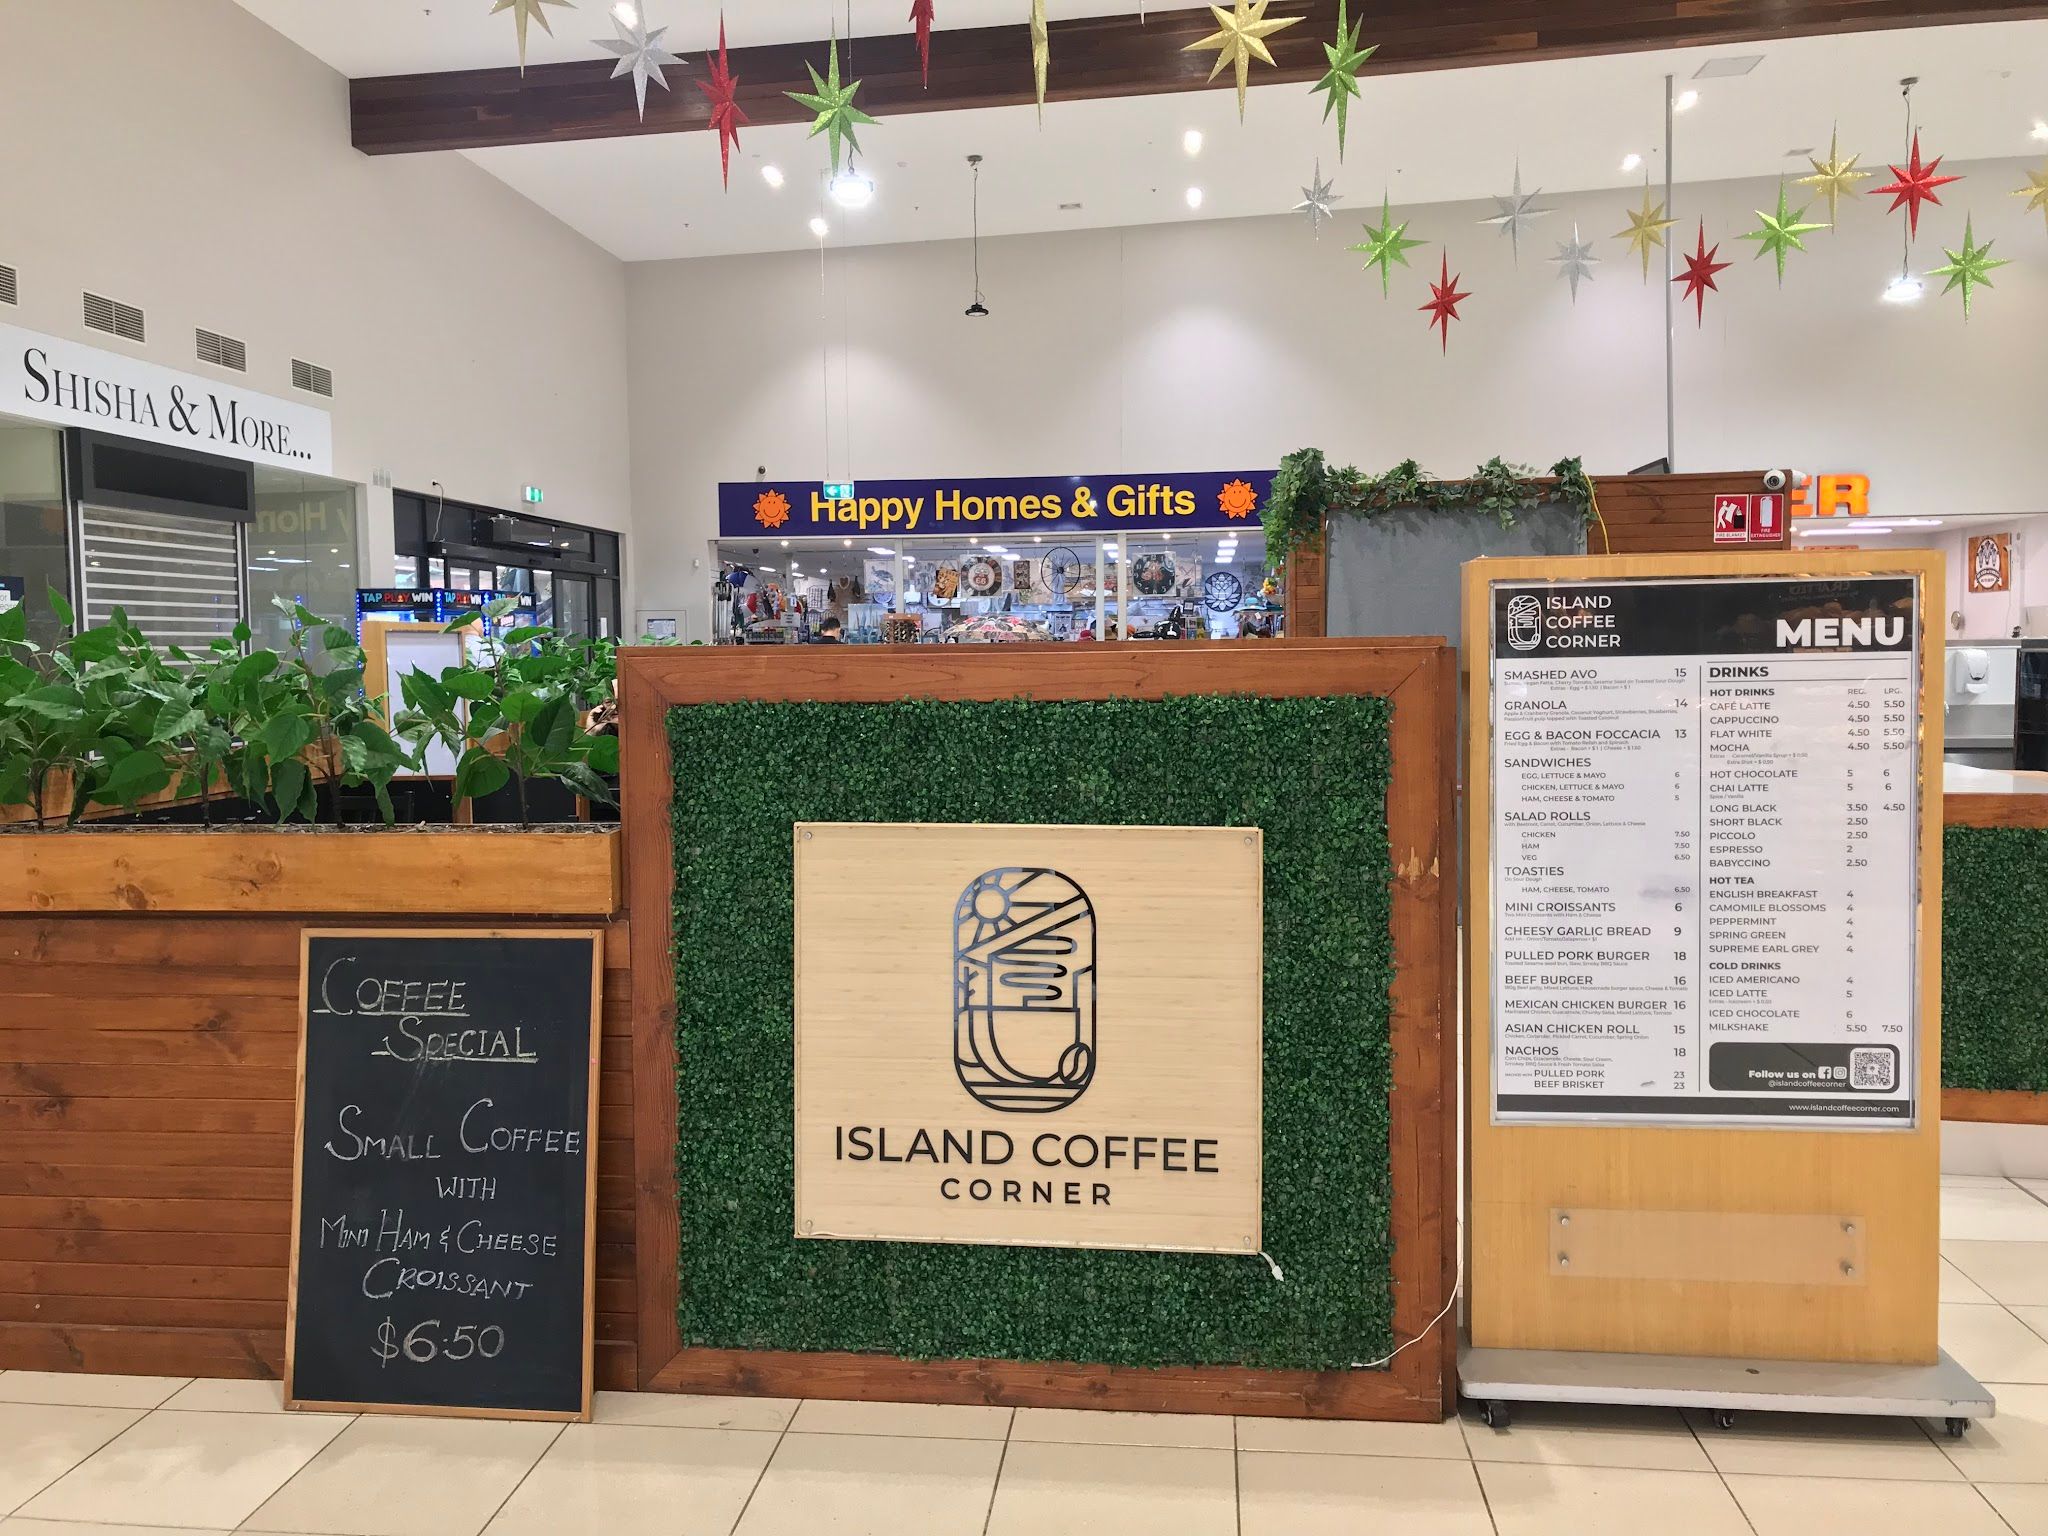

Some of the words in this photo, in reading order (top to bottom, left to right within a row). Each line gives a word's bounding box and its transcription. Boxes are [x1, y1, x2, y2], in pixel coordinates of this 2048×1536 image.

[168, 384, 200, 436] &
[811, 492, 924, 530] Happy
[935, 489, 1062, 521] Homes
[1071, 486, 1098, 518] &
[1106, 484, 1196, 517] Gifts
[363, 593, 382, 603] TAP
[411, 593, 433, 602] WIN
[445, 593, 456, 603] TAP
[1546, 596, 1611, 609] ISLAND
[1546, 615, 1615, 628] COFFEE
[1776, 617, 1904, 648] MENU
[1546, 634, 1620, 648] CORNER
[1504, 671, 1567, 680] SMASHED
[1570, 670, 1597, 678] AVO
[1675, 668, 1687, 677] 15
[1710, 666, 1769, 677] DRINKS
[1504, 701, 1567, 710] GRANOLA
[1675, 699, 1688, 708] 14
[1740, 702, 1770, 710] LATTE
[1883, 700, 1905, 708] 5.50
[1710, 716, 1779, 724] CAPPUCCINO
[1505, 731, 1530, 740] EGG
[1534, 731, 1542, 740] &
[1546, 730, 1591, 740] BACON
[1595, 729, 1660, 739] FOCCACIA
[1675, 729, 1687, 738] 13
[1504, 758, 1591, 768] SANDWICHES
[1710, 784, 1734, 792] CHAI
[1738, 784, 1768, 792] LATTE
[1743, 804, 1776, 812] BLACK
[1505, 812, 1546, 821] SALAD
[1551, 811, 1590, 821] ROLLS
[1748, 818, 1782, 826] BLACK
[1710, 832, 1755, 840] PICCOLO
[1505, 866, 1564, 875] TOASTIES
[1505, 903, 1533, 912] MINI
[1537, 902, 1616, 912] CROISSANTS
[1710, 904, 1765, 912] CAMOMILE
[1769, 904, 1826, 912] BLOSSOMS
[1505, 927, 1553, 935] CHEESY
[1557, 927, 1603, 936] GARLIC
[1607, 927, 1651, 936] BREAD
[1709, 945, 1759, 953] SUPREME
[1762, 945, 1788, 953] EARL
[1792, 945, 1819, 953] GREY
[1505, 951, 1554, 960] PULLED
[1558, 951, 1593, 960] PORK
[1598, 952, 1649, 961] BURGER
[1674, 952, 1686, 960] 18
[1710, 962, 1738, 970] COLD
[1741, 962, 1781, 970] DRINKS
[1505, 975, 1537, 984] BEEF
[1541, 975, 1593, 985] BURGER
[1674, 976, 1686, 985] 16
[1736, 976, 1800, 984] AMERICANO
[321, 957, 466, 1015] COFFEE
[1505, 1001, 1558, 1009] MEXICAN
[1562, 1001, 1614, 1009] CHICKEN
[1618, 1001, 1667, 1009] BURGER
[1674, 1001, 1686, 1009] 16
[1736, 1010, 1799, 1018] CHOCOLATE
[1505, 1024, 1543, 1033] ASIAN
[1547, 1024, 1603, 1033] CHICKEN
[1607, 1024, 1640, 1034] ROLL
[1674, 1025, 1685, 1034] 15
[1709, 1023, 1769, 1031] MILKSHAKE
[383, 1016, 536, 1062] SPECIAL
[1505, 1046, 1559, 1055] NACHOS
[1674, 1048, 1686, 1057] 18
[1749, 1070, 1783, 1078] Follow
[1789, 1104, 1900, 1112] www.islandcoffeecorner.com
[324, 1104, 441, 1161] SMALL
[460, 1098, 580, 1155] COFFEE
[836, 1125, 1014, 1165] ISLAND
[1031, 1132, 1220, 1173] COFFEE
[436, 1177, 496, 1200] WITH
[940, 1177, 1111, 1206] CORNER
[320, 1214, 368, 1248] MINI
[376, 1209, 430, 1252] HAM
[439, 1225, 450, 1252] &
[457, 1220, 557, 1256] CHEESE
[363, 1257, 533, 1299] CROISSANT
